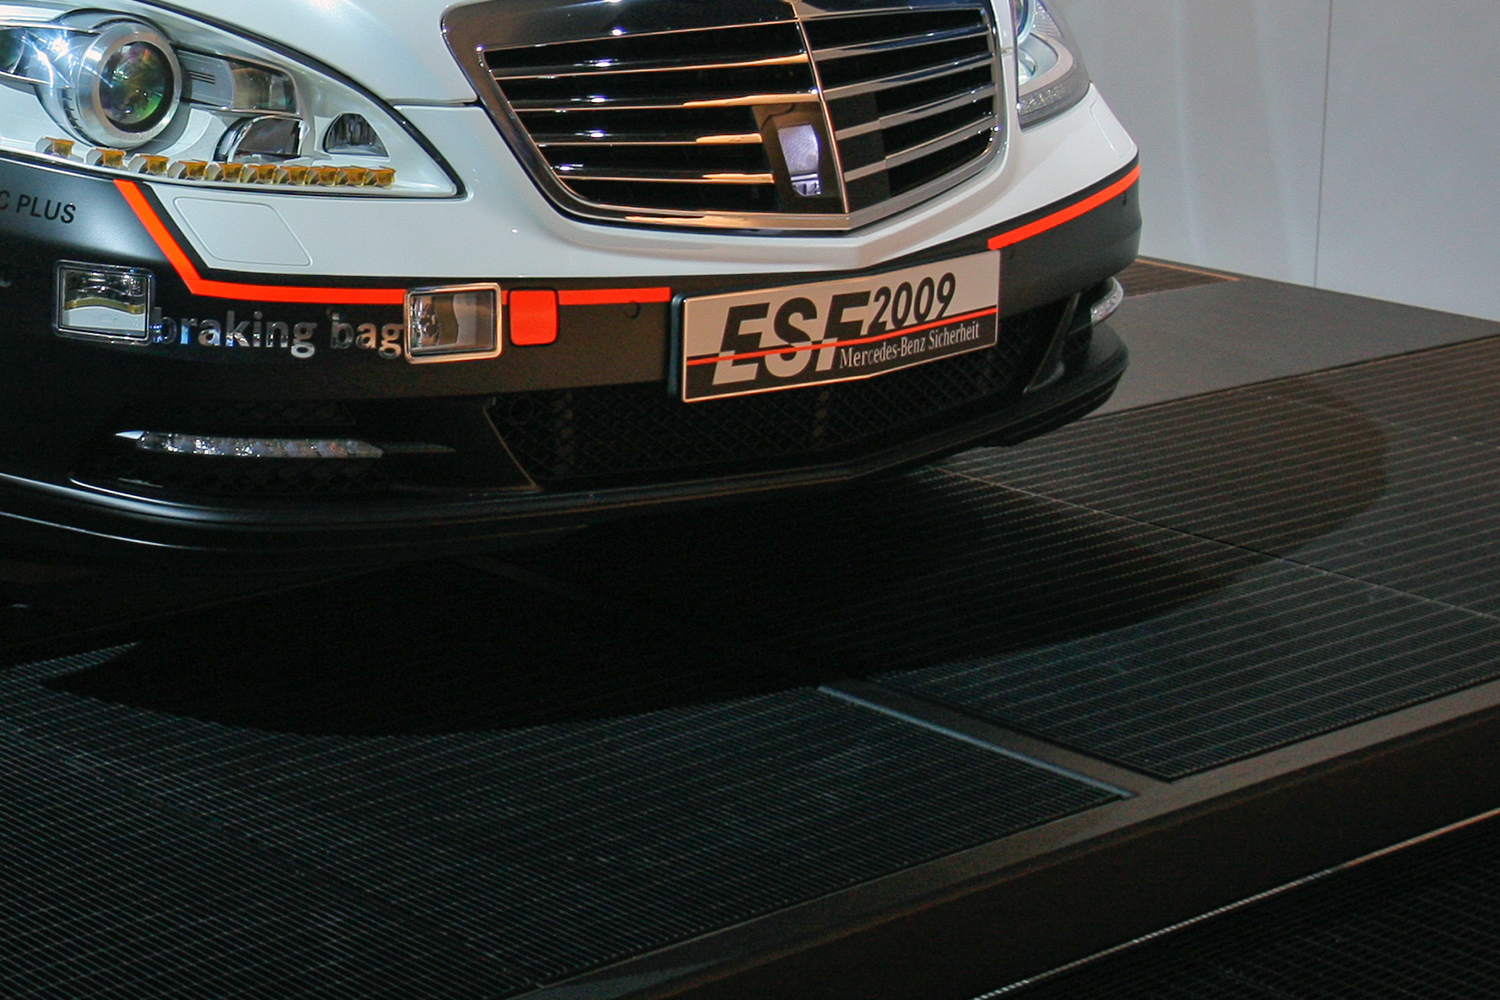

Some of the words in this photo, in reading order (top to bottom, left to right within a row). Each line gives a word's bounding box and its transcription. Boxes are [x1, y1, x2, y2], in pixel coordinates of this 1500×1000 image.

[15, 193, 77, 224] PLUS
[150, 307, 318, 358] braking
[330, 311, 407, 359] bag
[712, 290, 872, 386] ESF
[866, 272, 956, 332] 2009
[839, 333, 927, 369] Mercedes-Benz
[928, 320, 981, 350] Sicherheit
